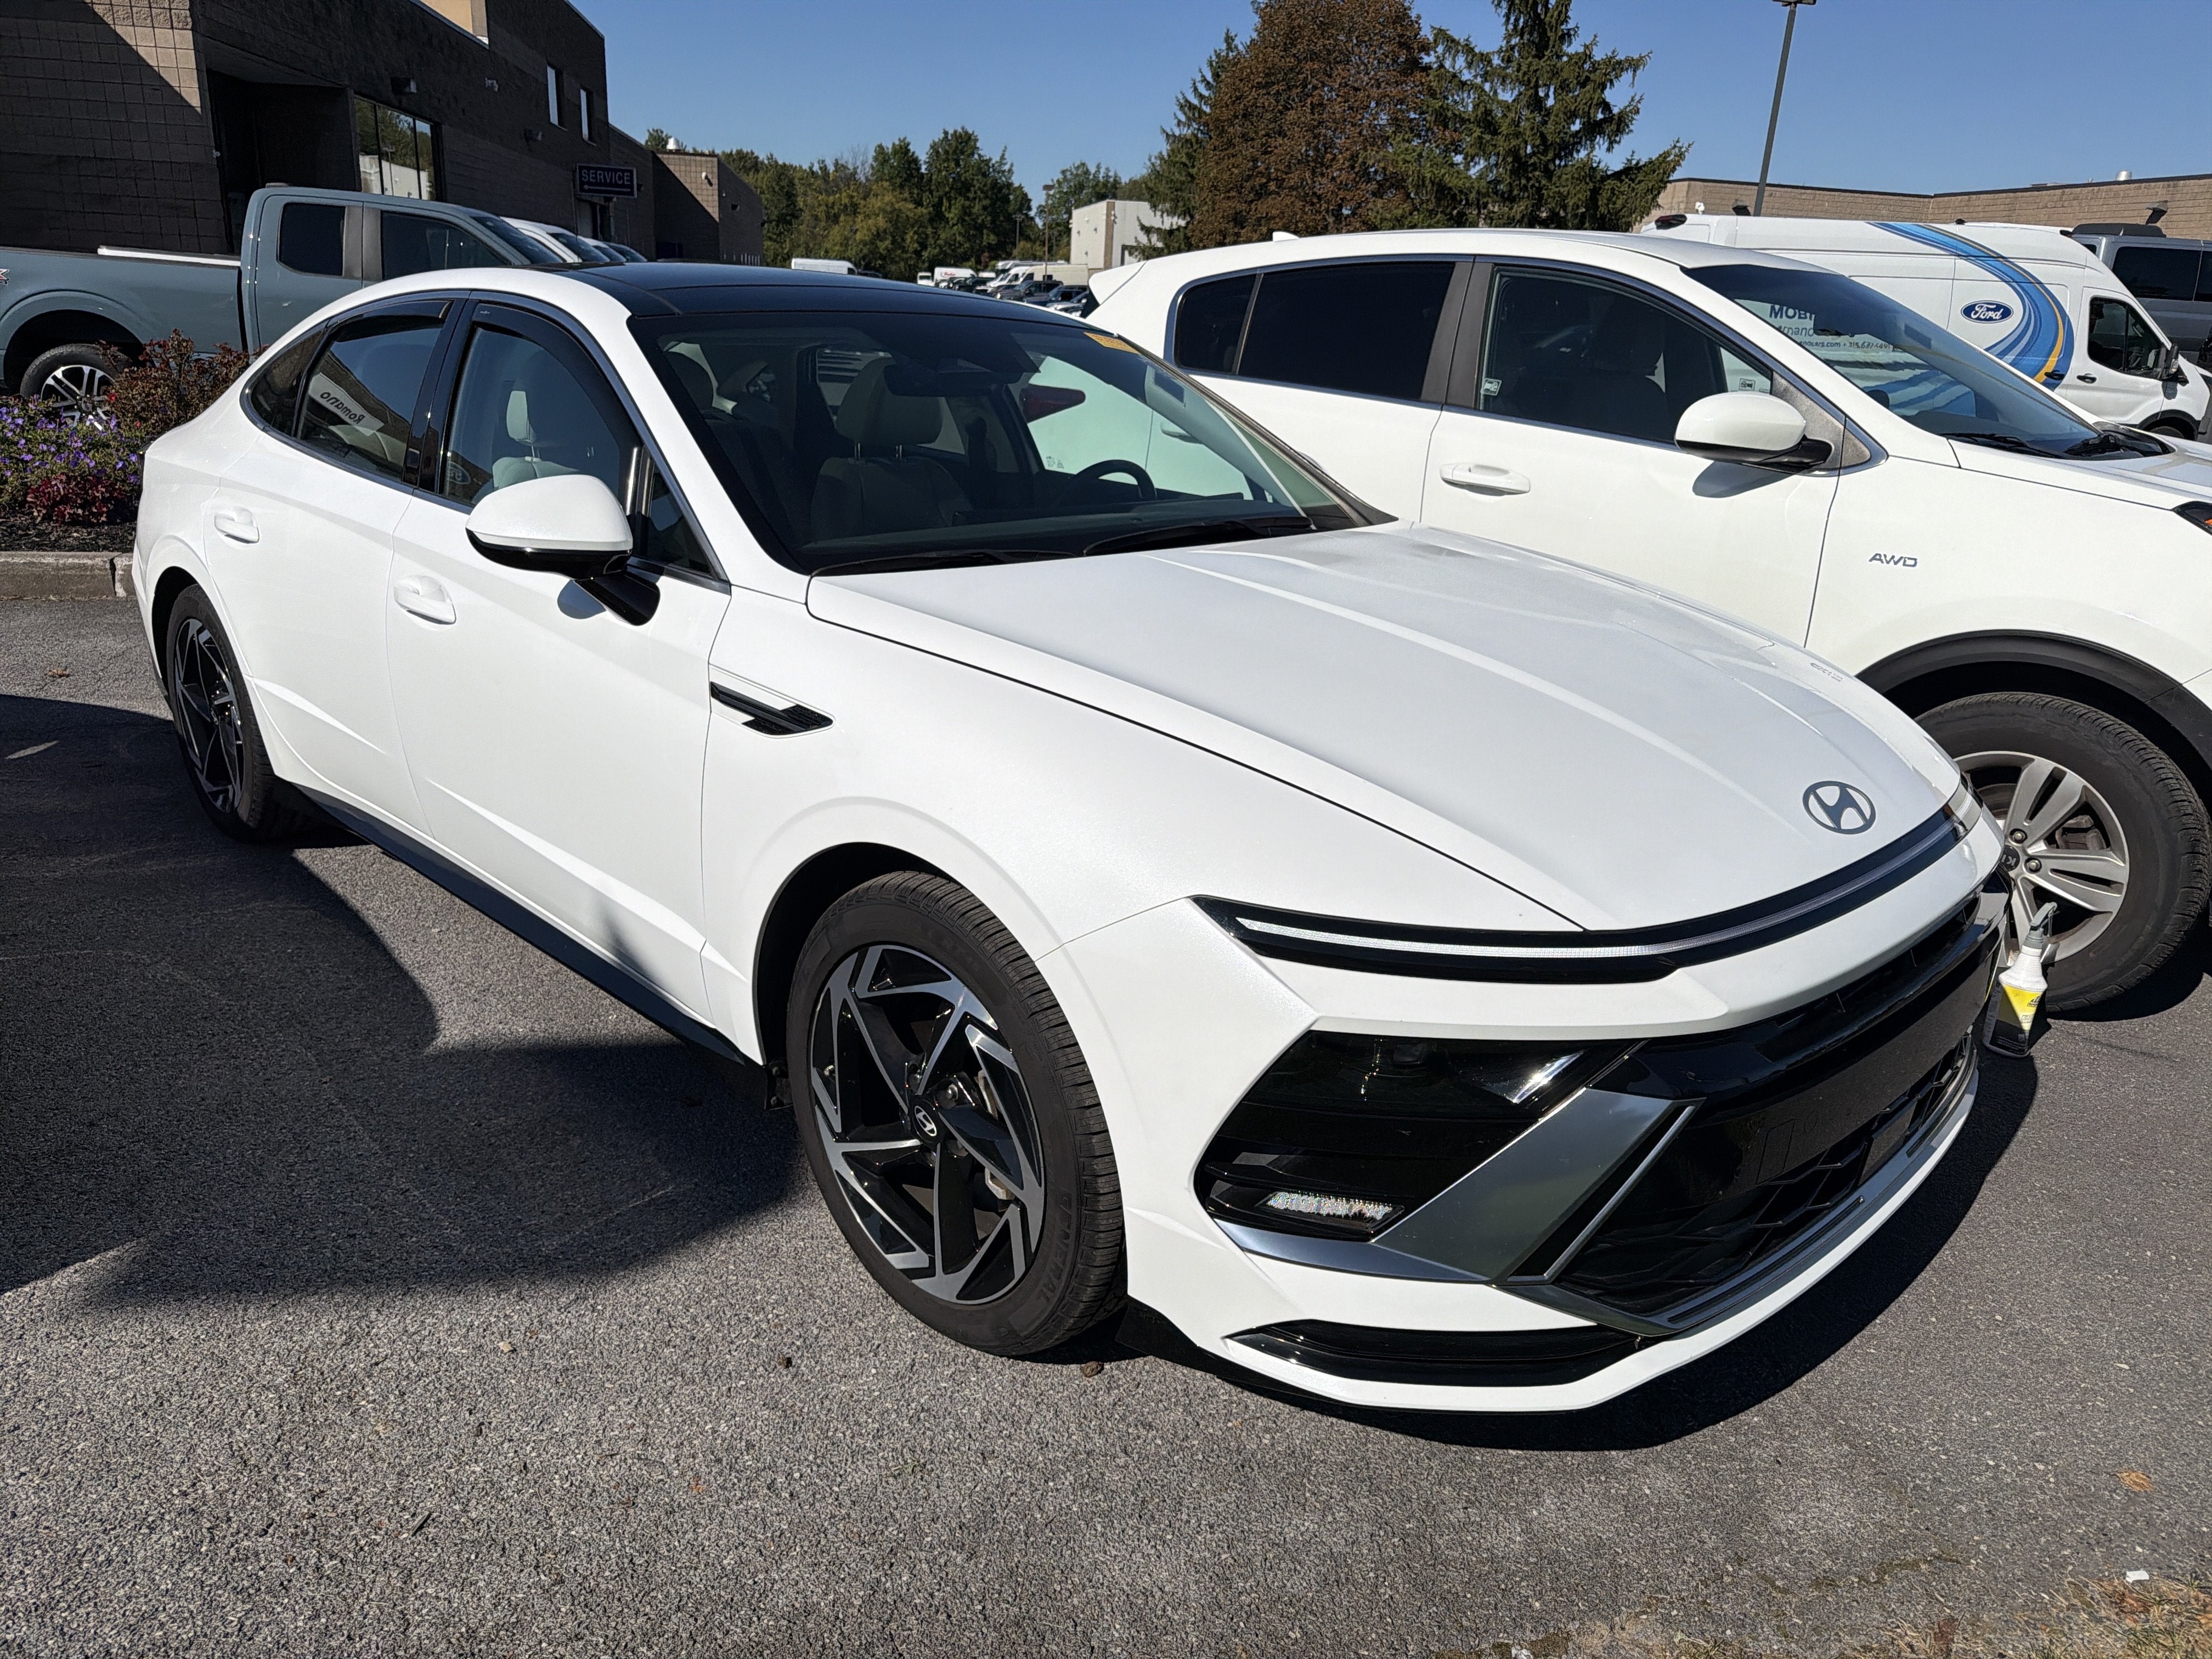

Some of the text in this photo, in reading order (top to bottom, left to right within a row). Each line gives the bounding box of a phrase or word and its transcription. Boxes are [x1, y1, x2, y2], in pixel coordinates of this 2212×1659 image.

[582, 169, 631, 185] SERVICE
[1769, 305, 1815, 321] MOBI
[1971, 303, 2002, 320] Ford
[1868, 552, 1918, 568] AWD
[2001, 854, 2017, 866] KI
